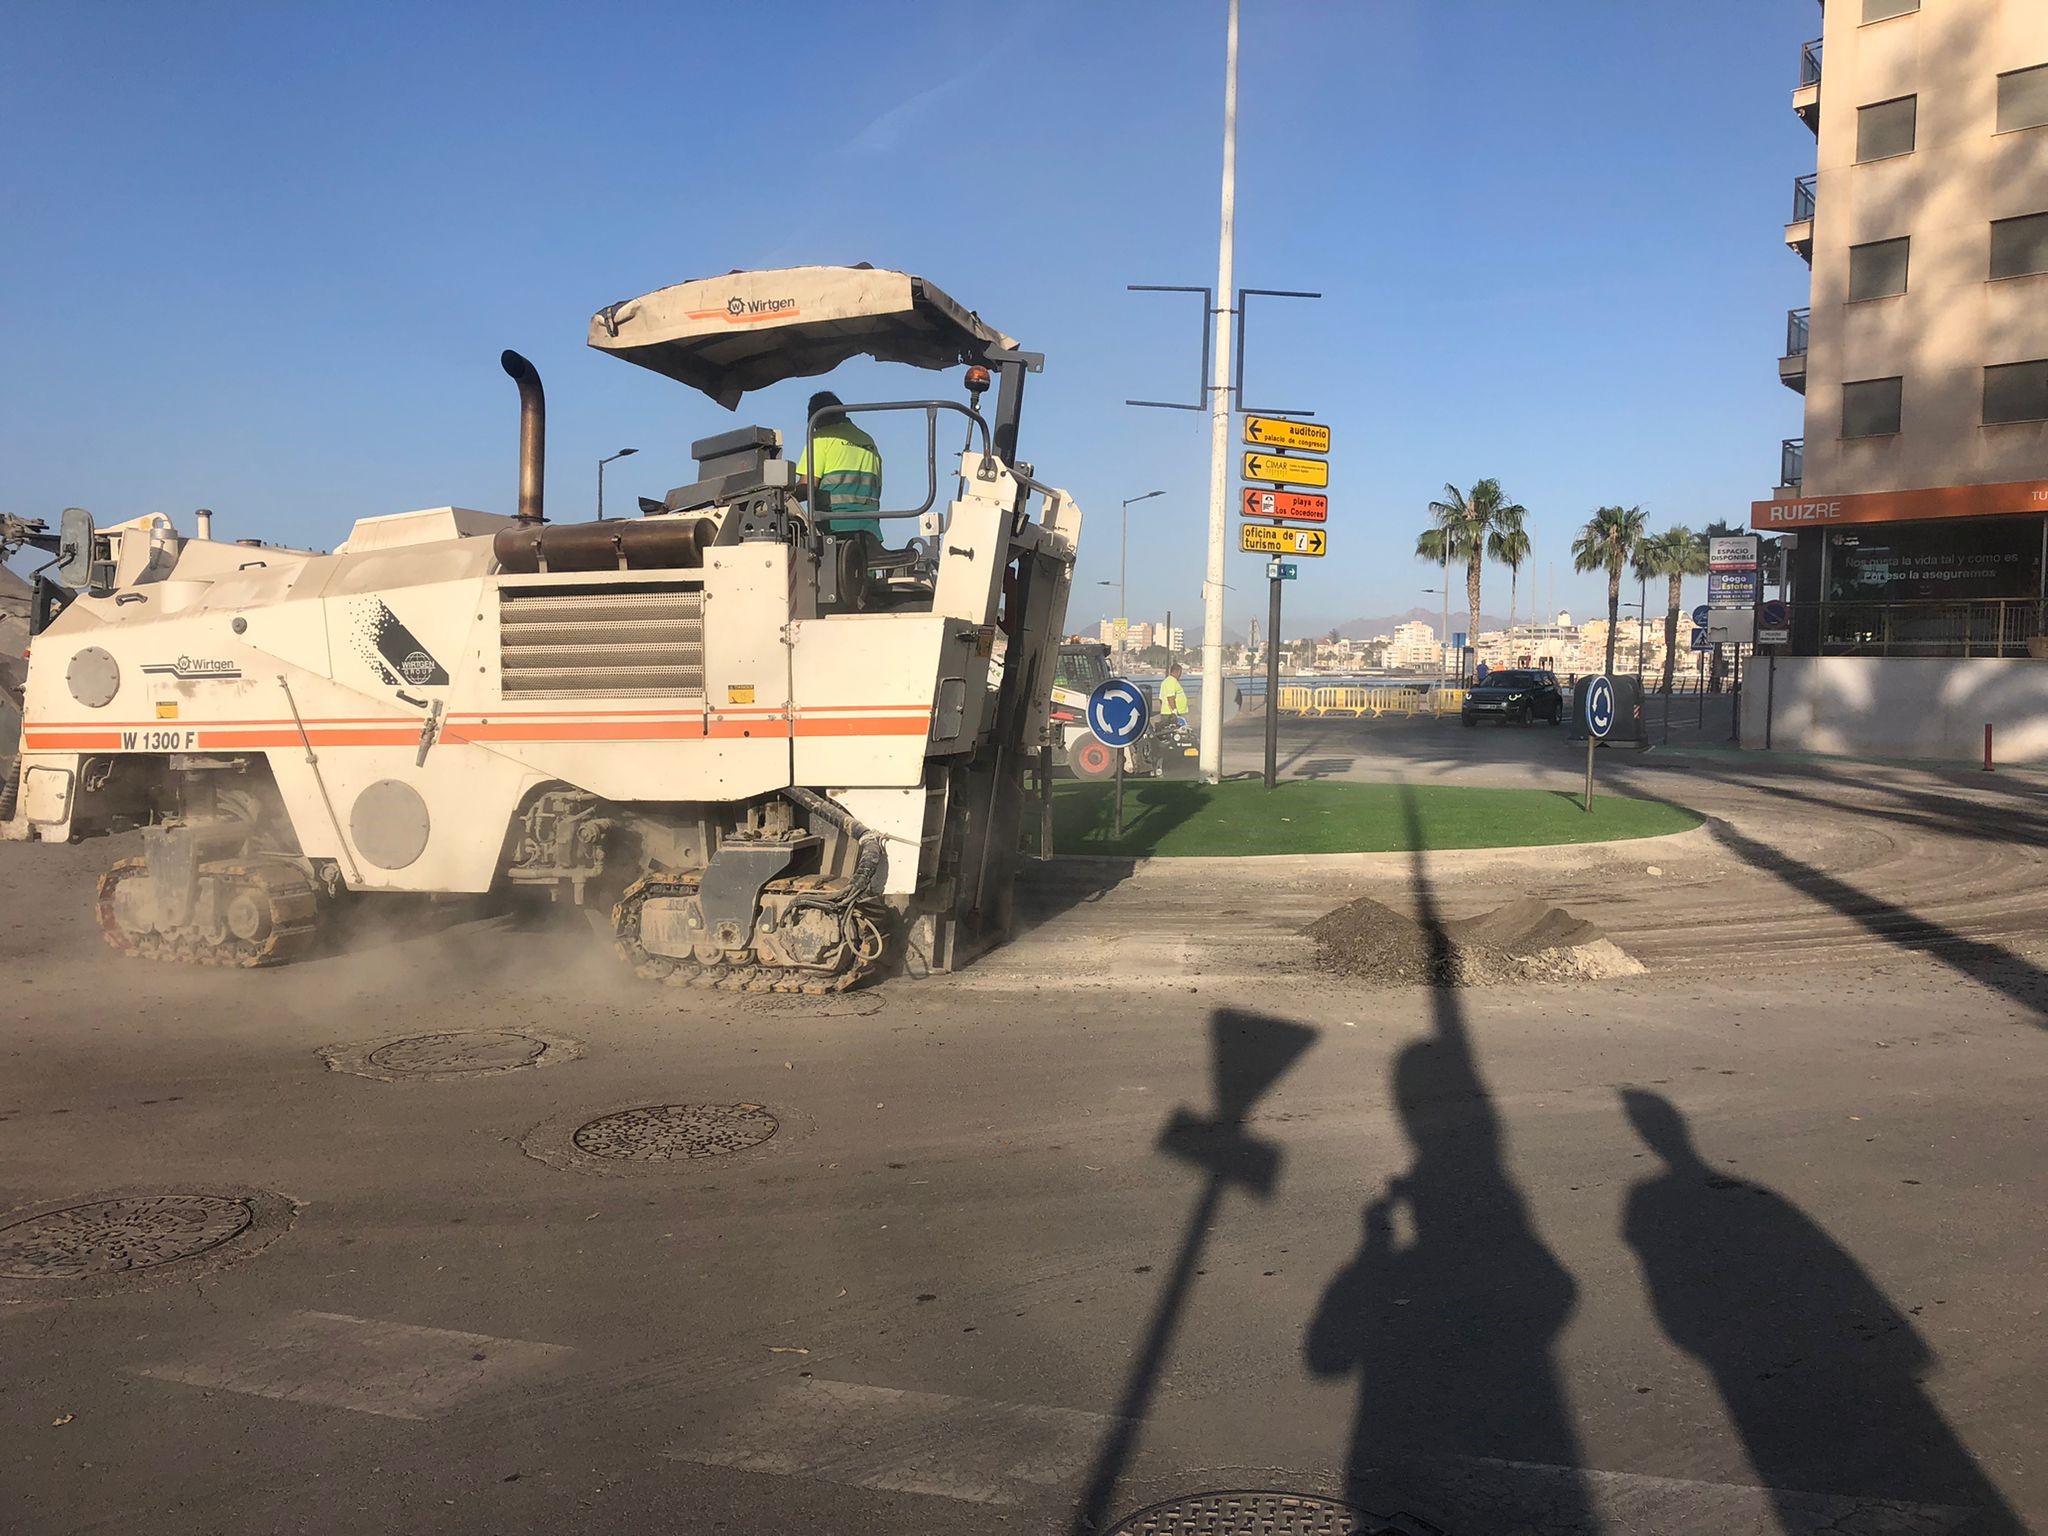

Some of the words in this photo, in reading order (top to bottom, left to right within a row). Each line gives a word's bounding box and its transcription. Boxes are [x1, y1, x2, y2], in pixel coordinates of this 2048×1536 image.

[747, 298, 795, 313] Wirtgen
[1289, 425, 1327, 438] auditorio
[1264, 434, 1286, 443] palacio
[1288, 436, 1295, 444] de
[1298, 438, 1326, 449] congresos
[1265, 460, 1288, 470] CIMAR
[1293, 497, 1311, 507] playa
[2032, 491, 2048, 501] TU
[1275, 507, 1287, 515] Los
[1290, 507, 1324, 518] Cocedores
[1770, 502, 1841, 521] RUIZRE
[1245, 527, 1277, 540] oficina
[1282, 531, 1294, 540] de
[1245, 538, 1282, 550] turismo
[1902, 556, 1912, 565] la
[1914, 555, 1938, 565] vida
[1941, 554, 1955, 564] tal
[1957, 556, 1964, 566] y
[1967, 554, 2001, 564] como
[2003, 553, 2019, 562] es
[1721, 575, 1747, 583] Gogo
[1863, 571, 1882, 581] Por
[1886, 571, 1906, 580] eso
[1909, 570, 1919, 580] la
[1922, 569, 1997, 582] aseguramos
[192, 659, 234, 671] Wirtgen
[401, 660, 435, 669] WIRTGEN
[123, 732, 138, 750] W
[143, 732, 180, 750] 1300
[185, 732, 195, 749] F
